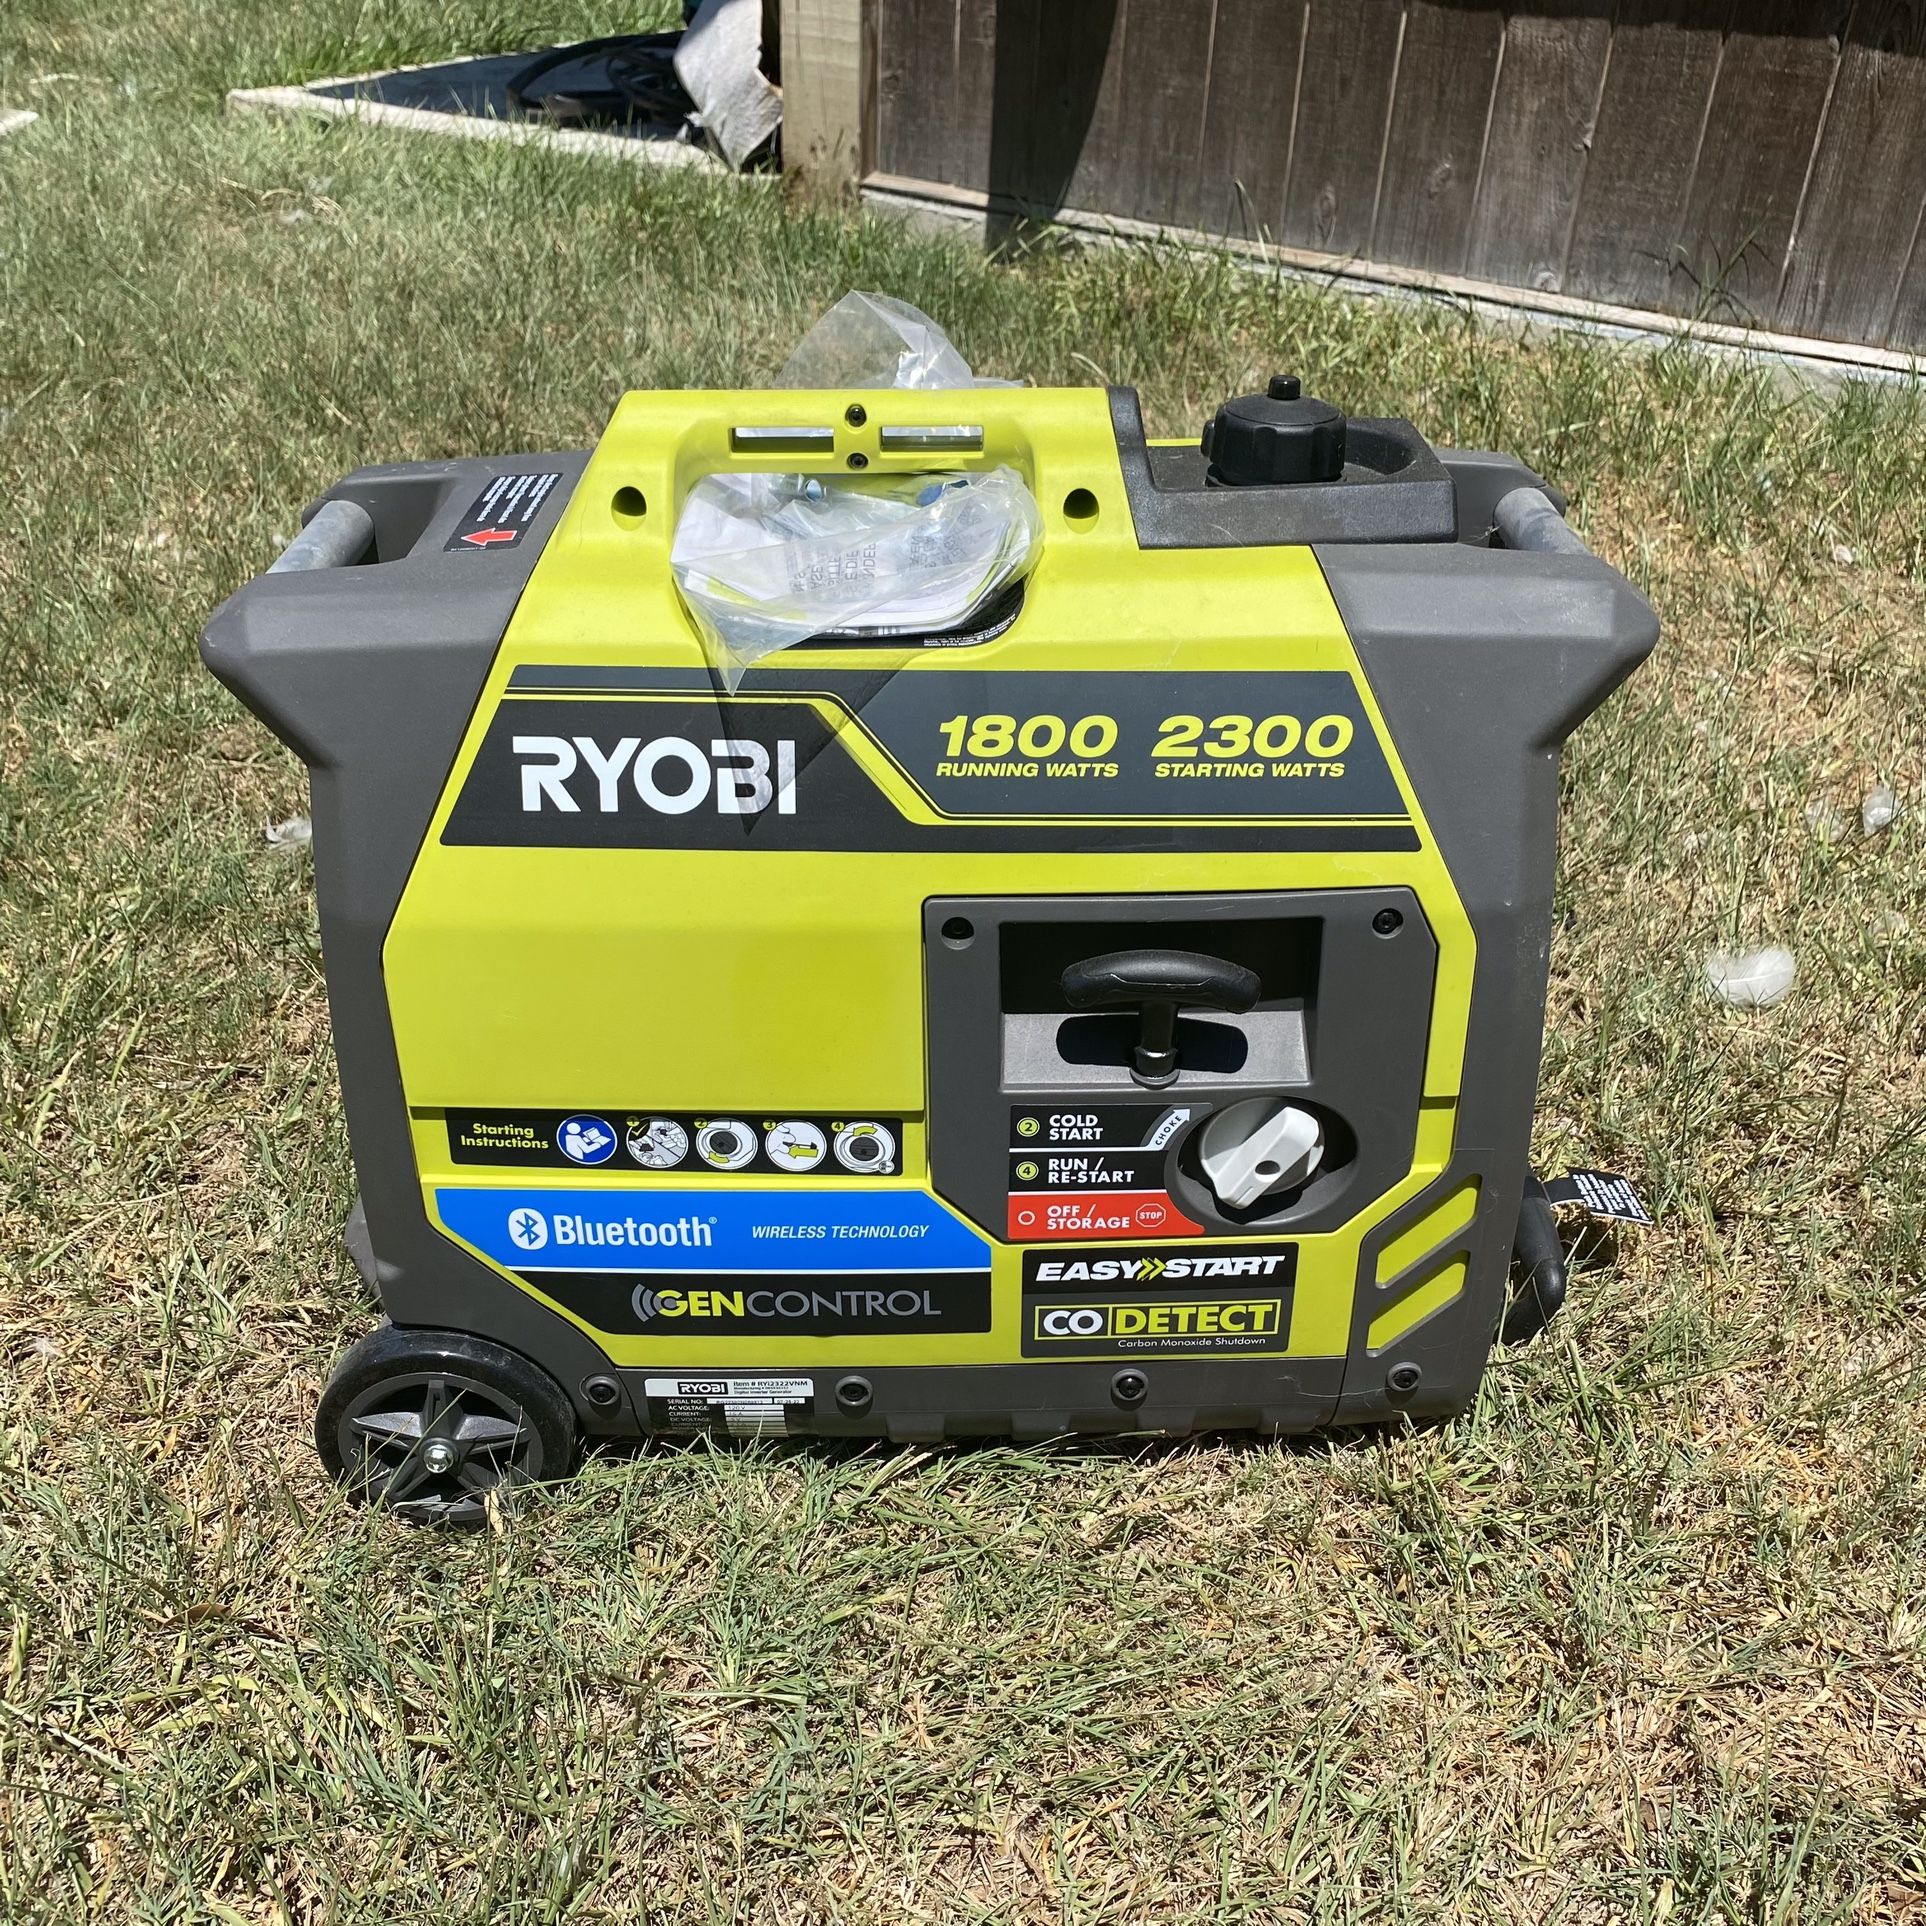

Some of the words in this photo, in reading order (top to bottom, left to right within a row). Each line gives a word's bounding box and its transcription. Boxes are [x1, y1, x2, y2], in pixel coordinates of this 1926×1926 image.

[939, 714, 1118, 758] 1800
[1151, 714, 1354, 758] 2300
[512, 736, 797, 815] RYOBI
[936, 762, 1039, 777] RUNNING
[1046, 762, 1119, 777] WATTS
[1154, 762, 1265, 777] STARTING
[1272, 762, 1345, 777] WATTS
[1049, 1114, 1098, 1127] COLD
[472, 1122, 534, 1138] Starting
[1049, 1128, 1103, 1141] START
[1155, 1115, 1182, 1146] CHOKE
[461, 1135, 549, 1149] Instructions
[1048, 1158, 1088, 1171] RUN
[1048, 1170, 1134, 1184] RE-START
[1047, 1205, 1080, 1217] OFF
[1139, 1211, 1162, 1220] STOP
[1047, 1217, 1130, 1230] STORAGE
[752, 1225, 826, 1239] WIRELESS
[831, 1225, 929, 1239] TECHNOLOGY
[1043, 1310, 1103, 1335] CO
[1115, 1304, 1273, 1334] DETECT
[1118, 1339, 1158, 1348] Carbon
[1160, 1338, 1212, 1347] Monoxide
[1215, 1337, 1266, 1346] Shutdown
[679, 1383, 726, 1393] RYOBI
